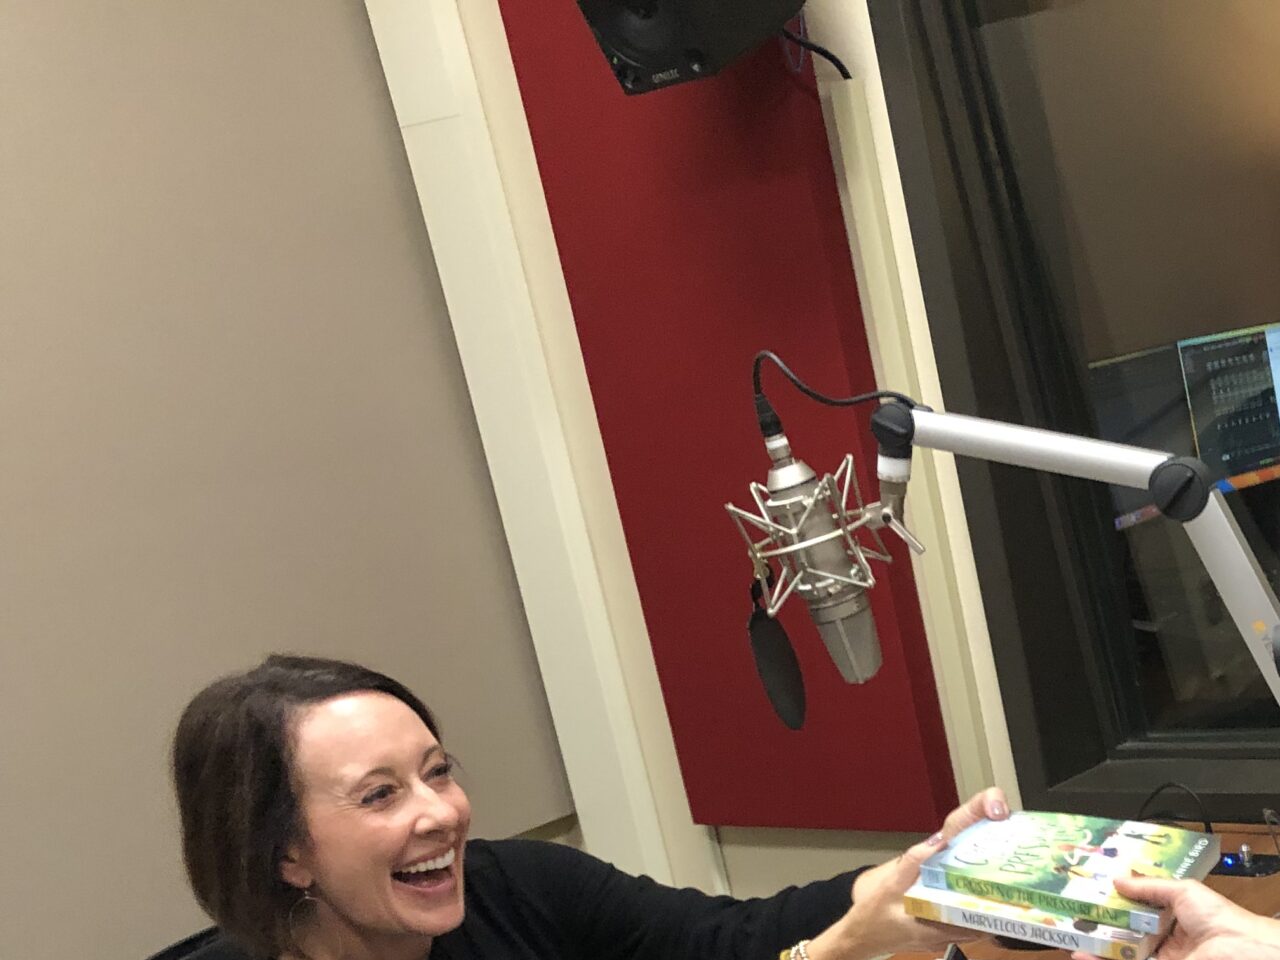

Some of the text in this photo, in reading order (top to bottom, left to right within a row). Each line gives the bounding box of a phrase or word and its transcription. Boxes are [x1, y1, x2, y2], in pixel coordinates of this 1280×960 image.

[1188, 838, 1208, 858] BIRD
[1038, 894, 1091, 917] PRESSURE
[961, 911, 1081, 949] MARVELOUS JACKSON
